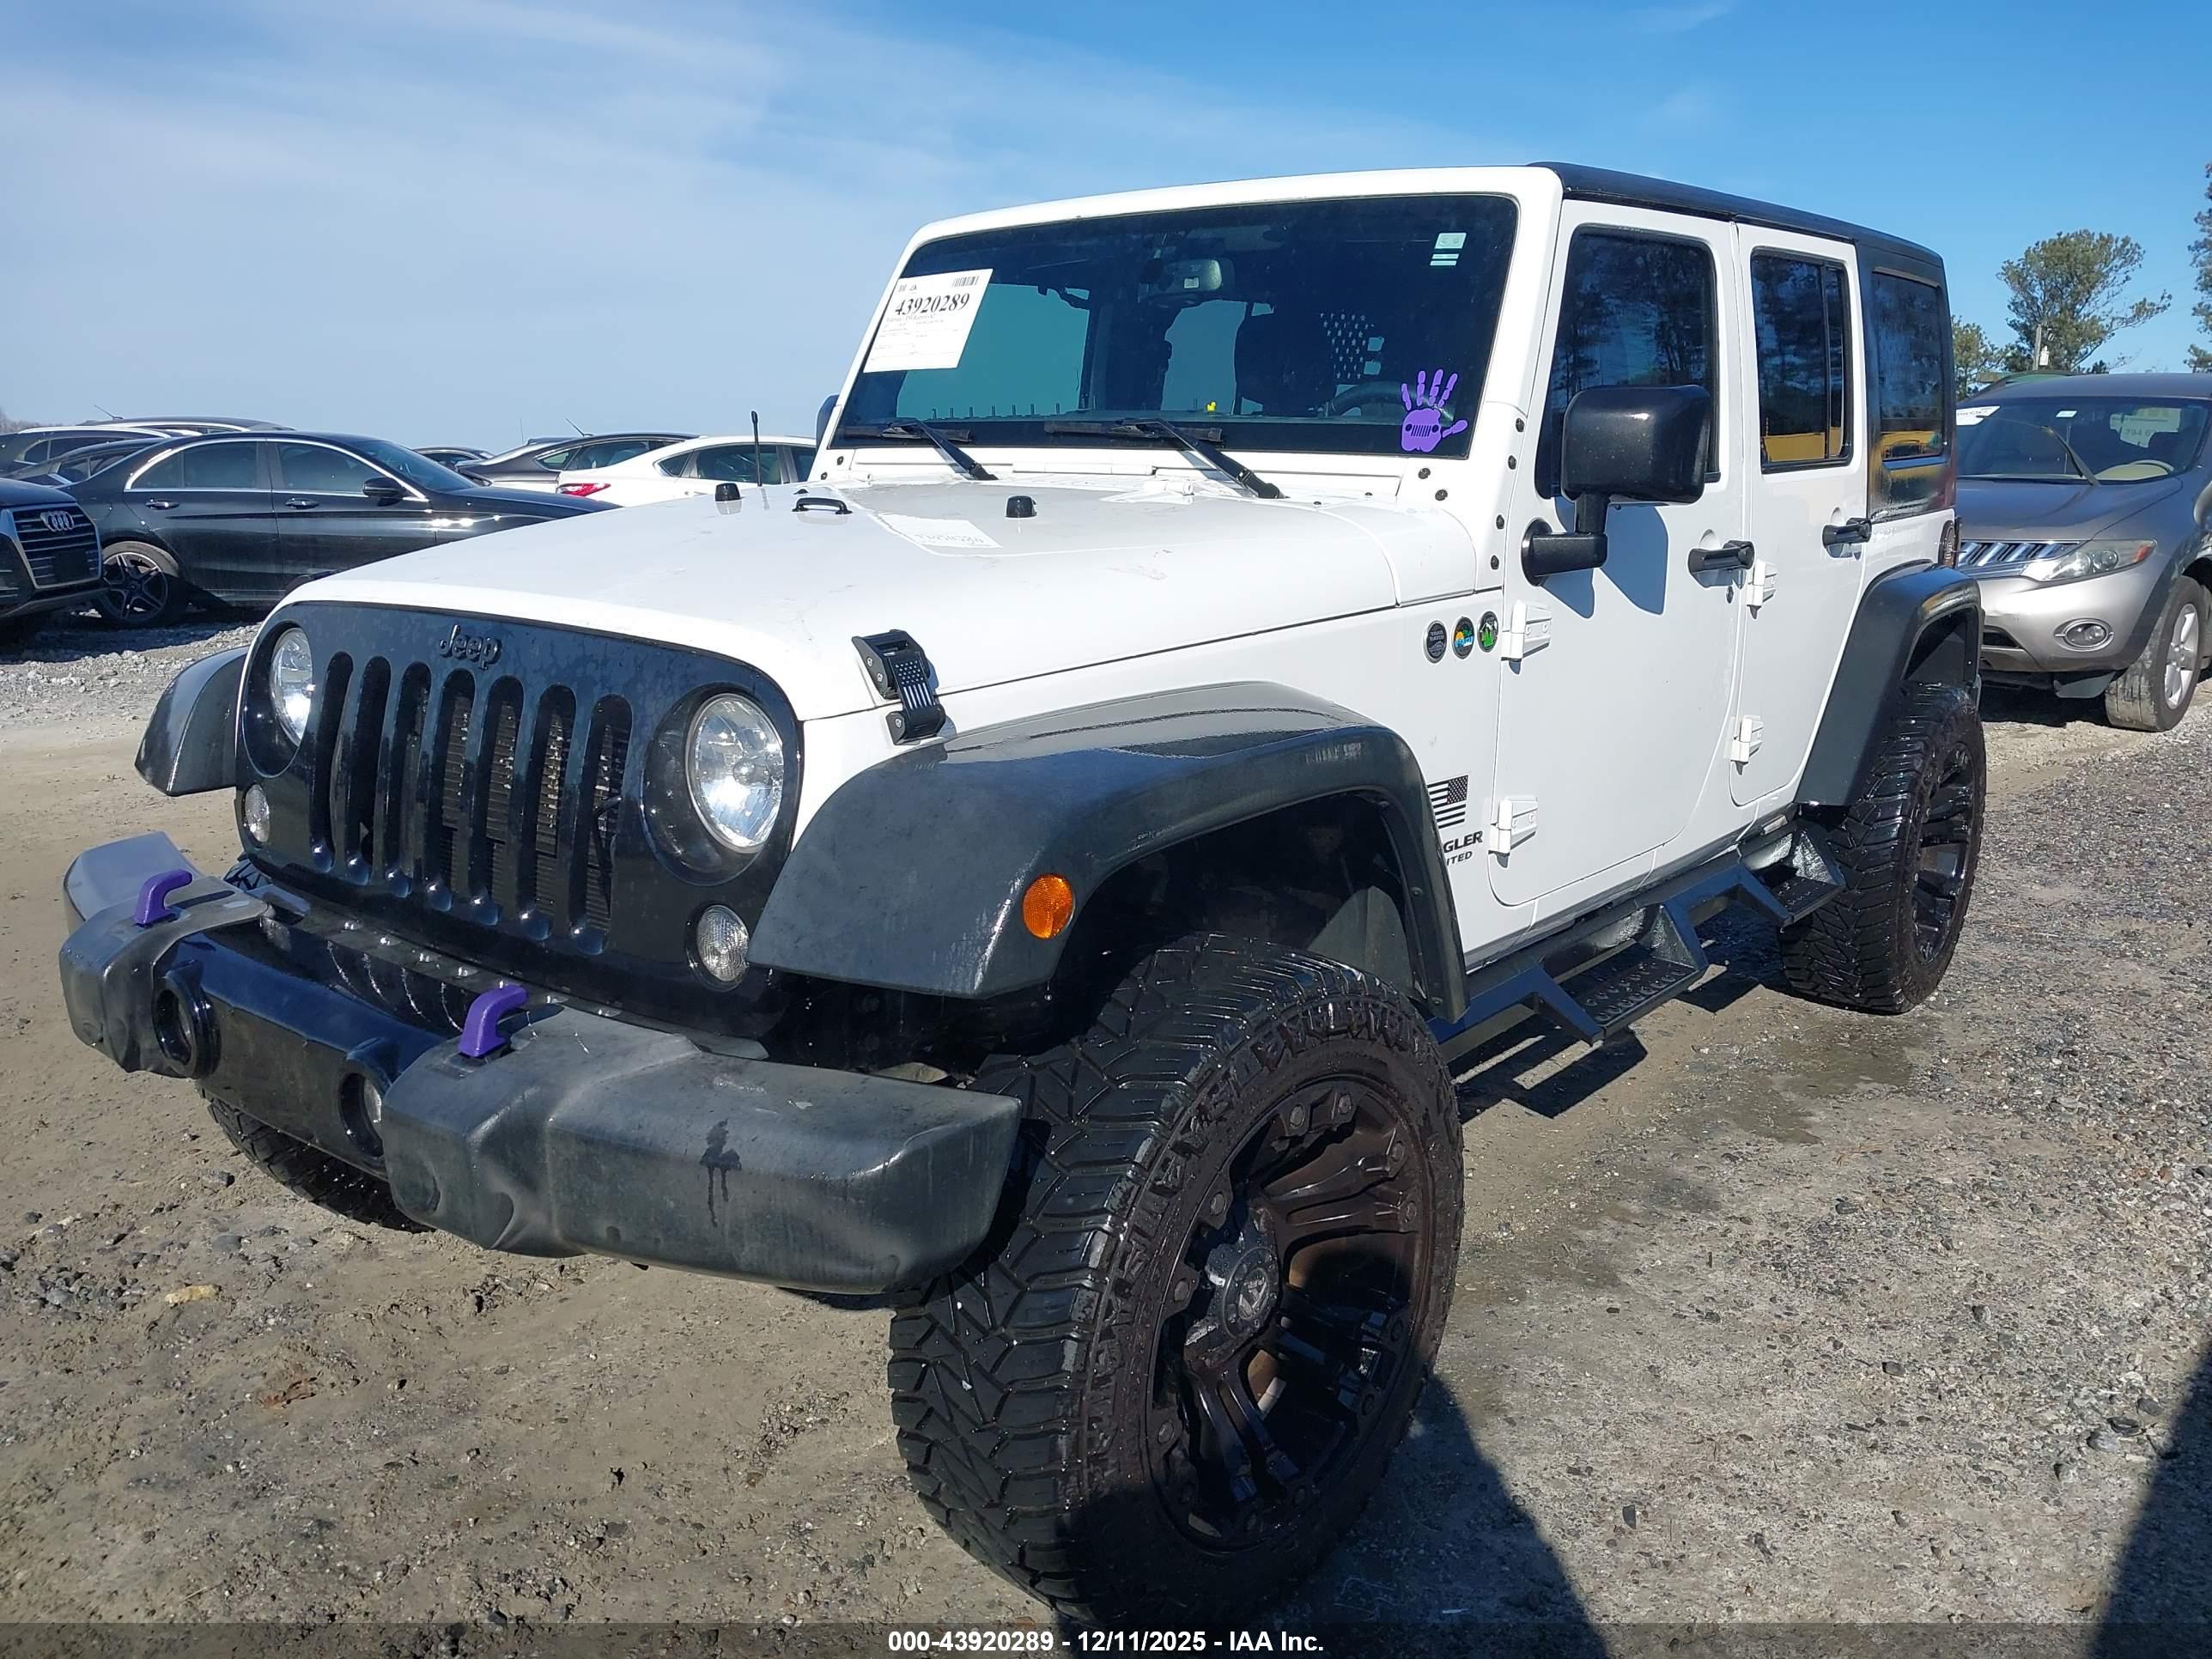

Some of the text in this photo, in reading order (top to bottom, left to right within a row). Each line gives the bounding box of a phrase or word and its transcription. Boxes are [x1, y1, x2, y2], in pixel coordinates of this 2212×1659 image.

[895, 293, 970, 315] 43920289
[440, 624, 502, 671] Jeep
[1443, 830, 1484, 853] GLER
